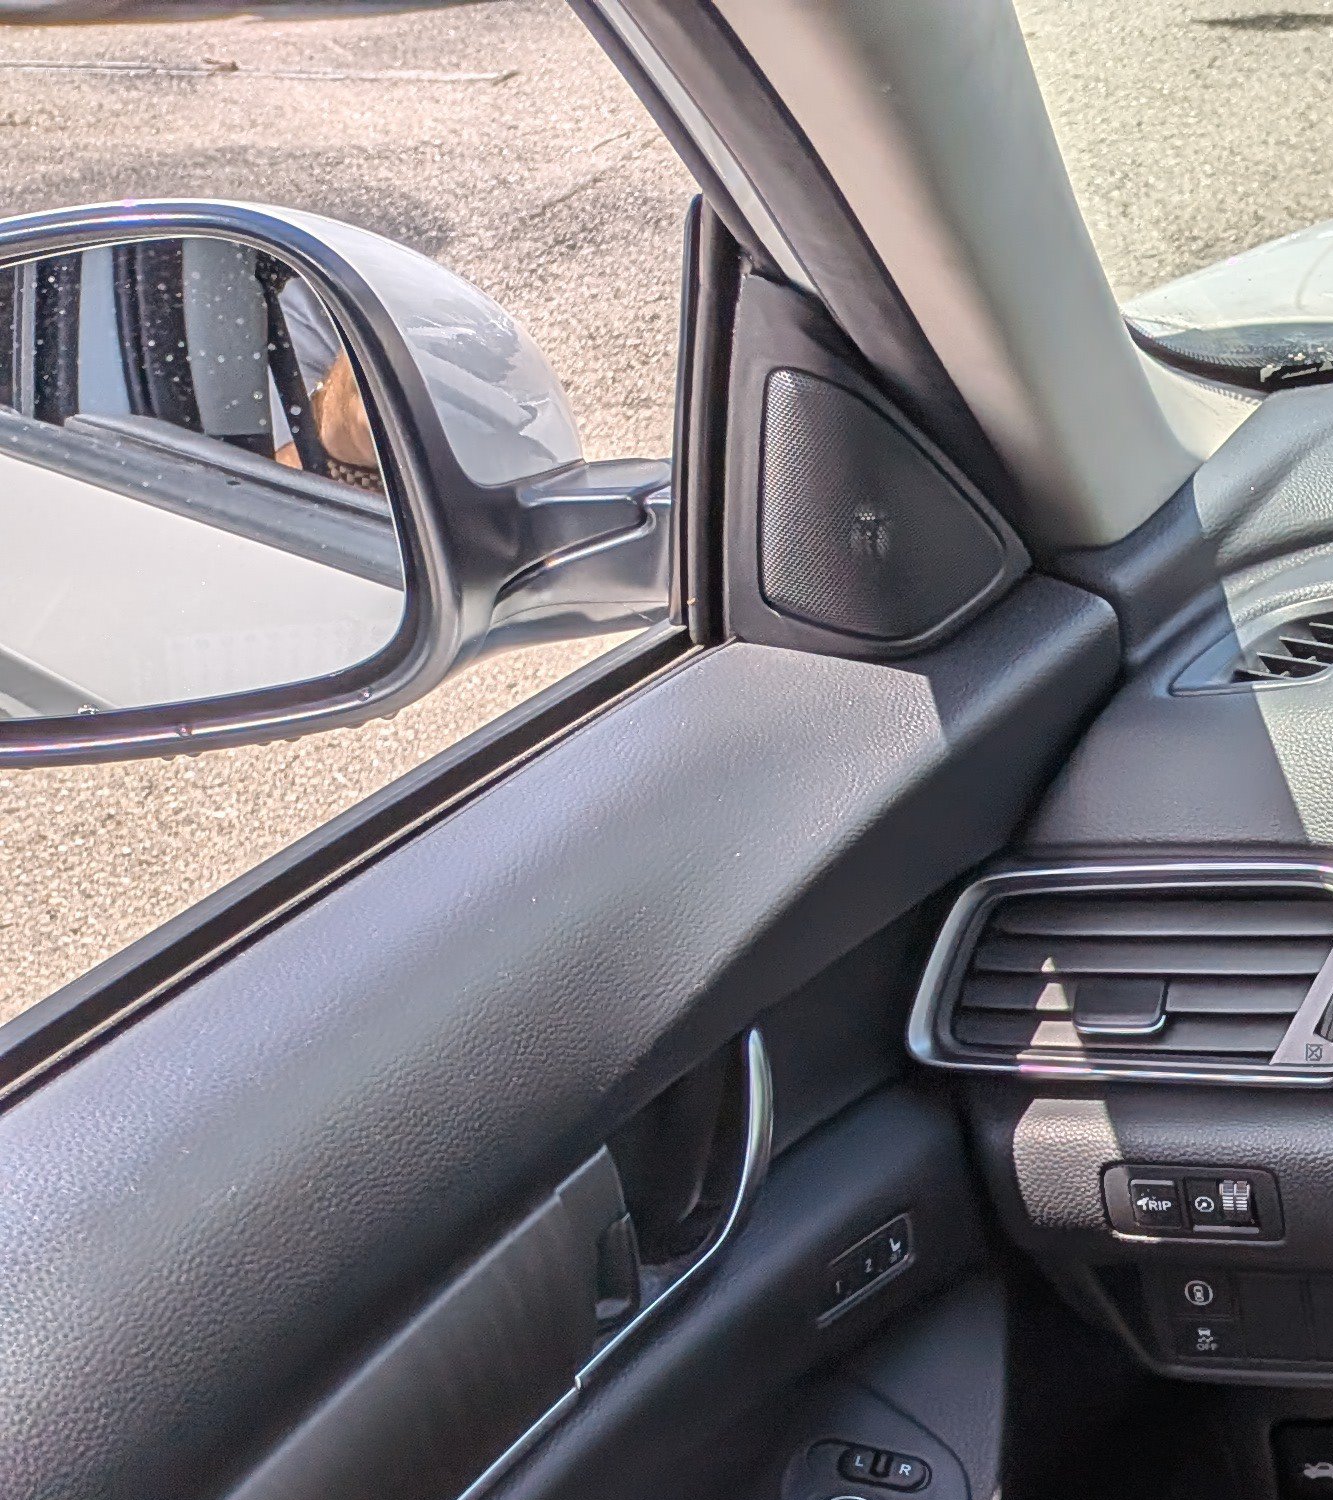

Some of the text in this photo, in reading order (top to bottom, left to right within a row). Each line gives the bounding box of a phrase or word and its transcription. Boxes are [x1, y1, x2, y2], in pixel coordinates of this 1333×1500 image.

[1137, 1197, 1172, 1212] TRIP
[854, 1455, 864, 1468] L
[898, 1463, 912, 1476] R
